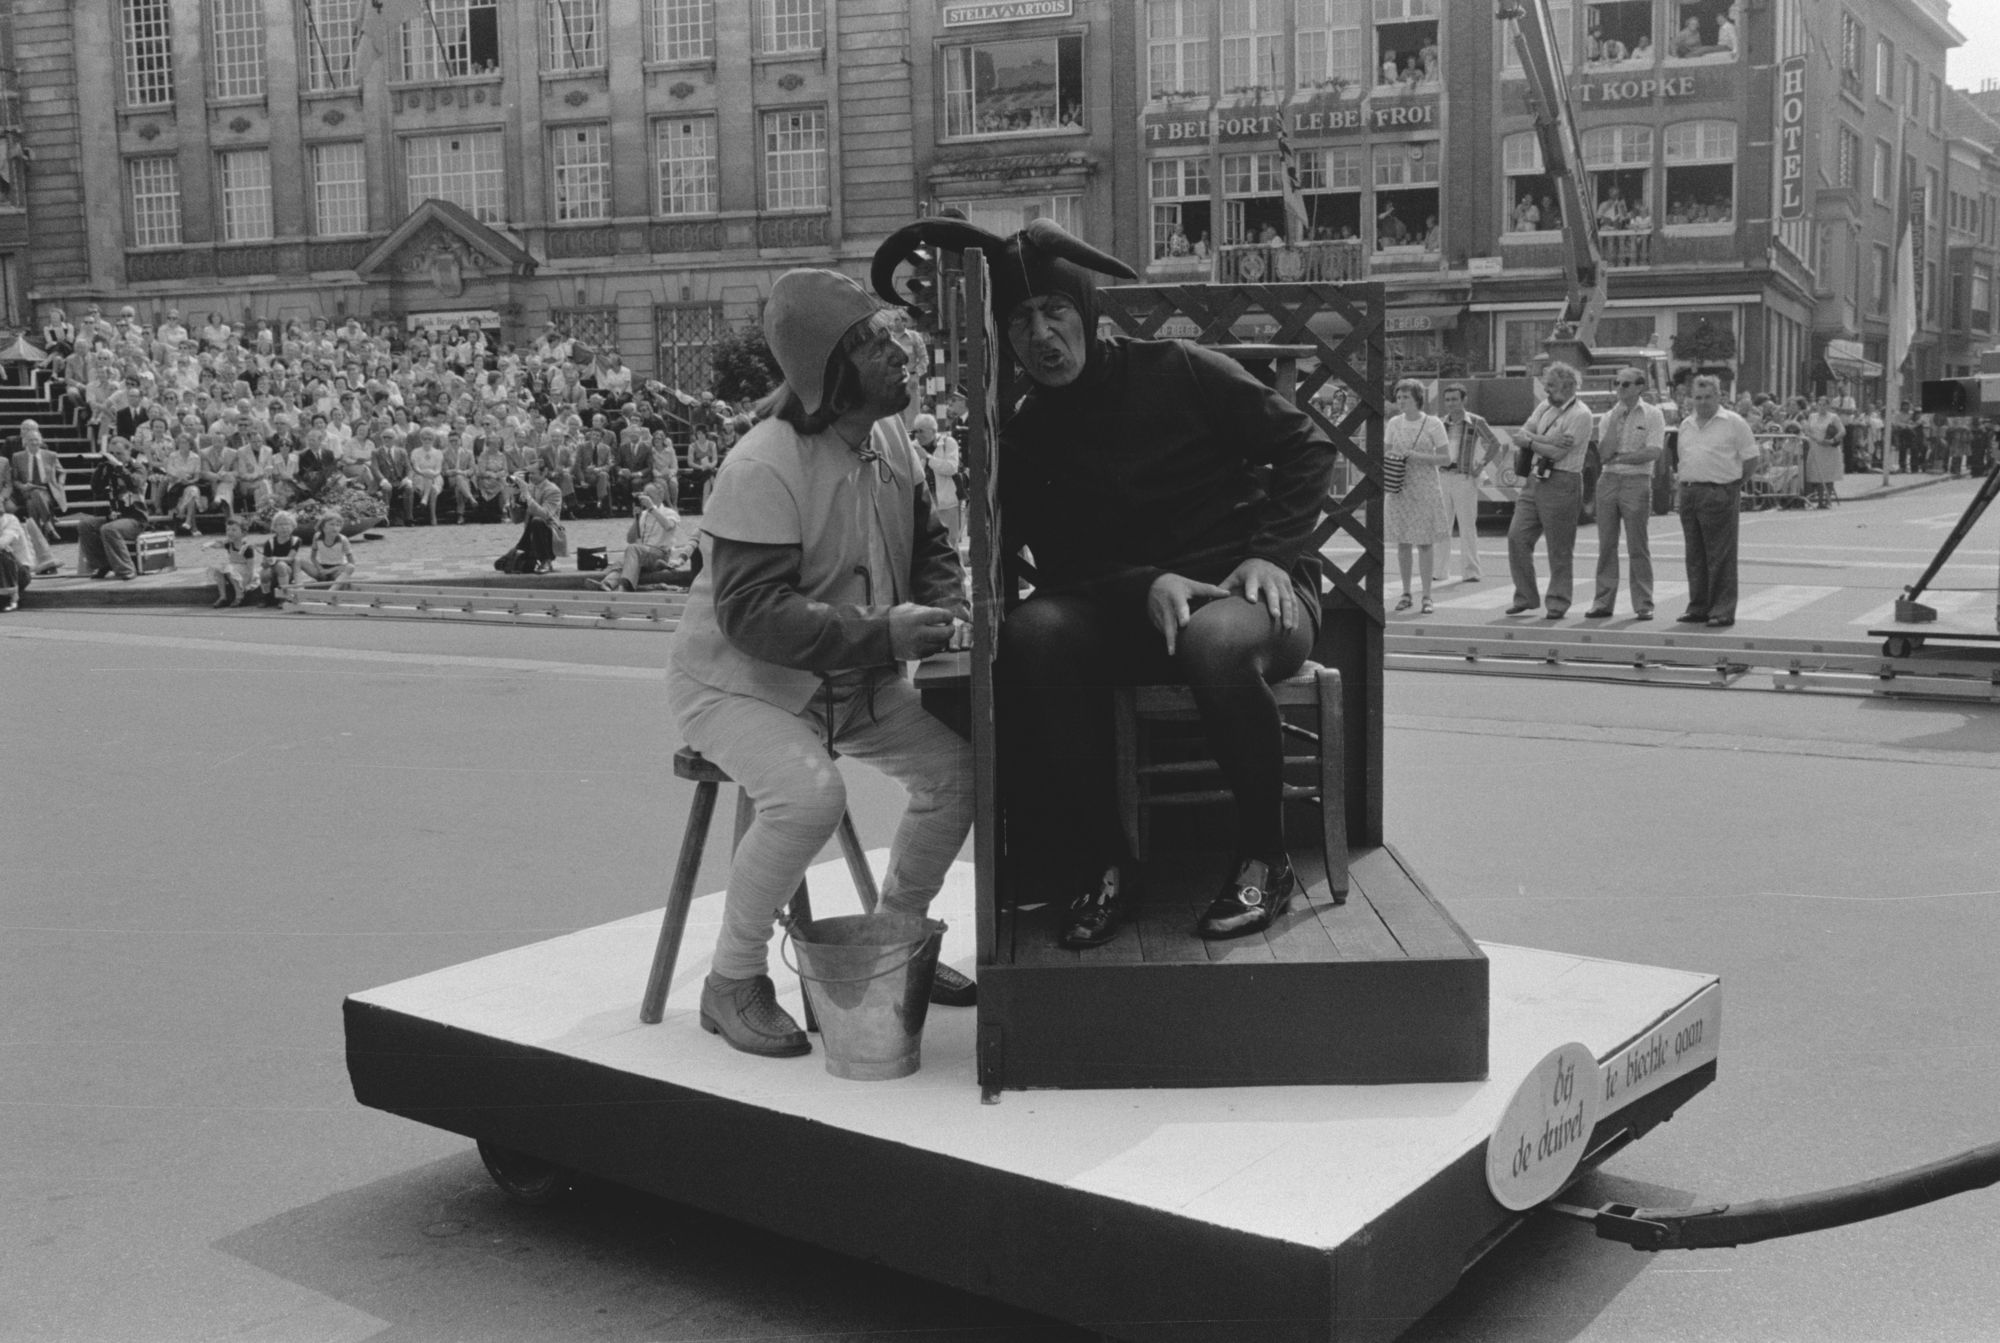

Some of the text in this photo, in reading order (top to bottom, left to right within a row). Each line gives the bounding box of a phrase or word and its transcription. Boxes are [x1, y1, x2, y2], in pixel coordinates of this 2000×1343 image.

[950, 1, 1065, 22] STELLA ARTOIS
[1602, 76, 1695, 100] KOPKE
[1168, 116, 1273, 139] BELFORT
[1295, 105, 1432, 130] LE BEFFROI
[1783, 69, 1803, 208] HOTEL
[1606, 1019, 1703, 1100] te biechte gaan
[1554, 1054, 1575, 1109] bij
[1513, 1100, 1583, 1177] de duivel
